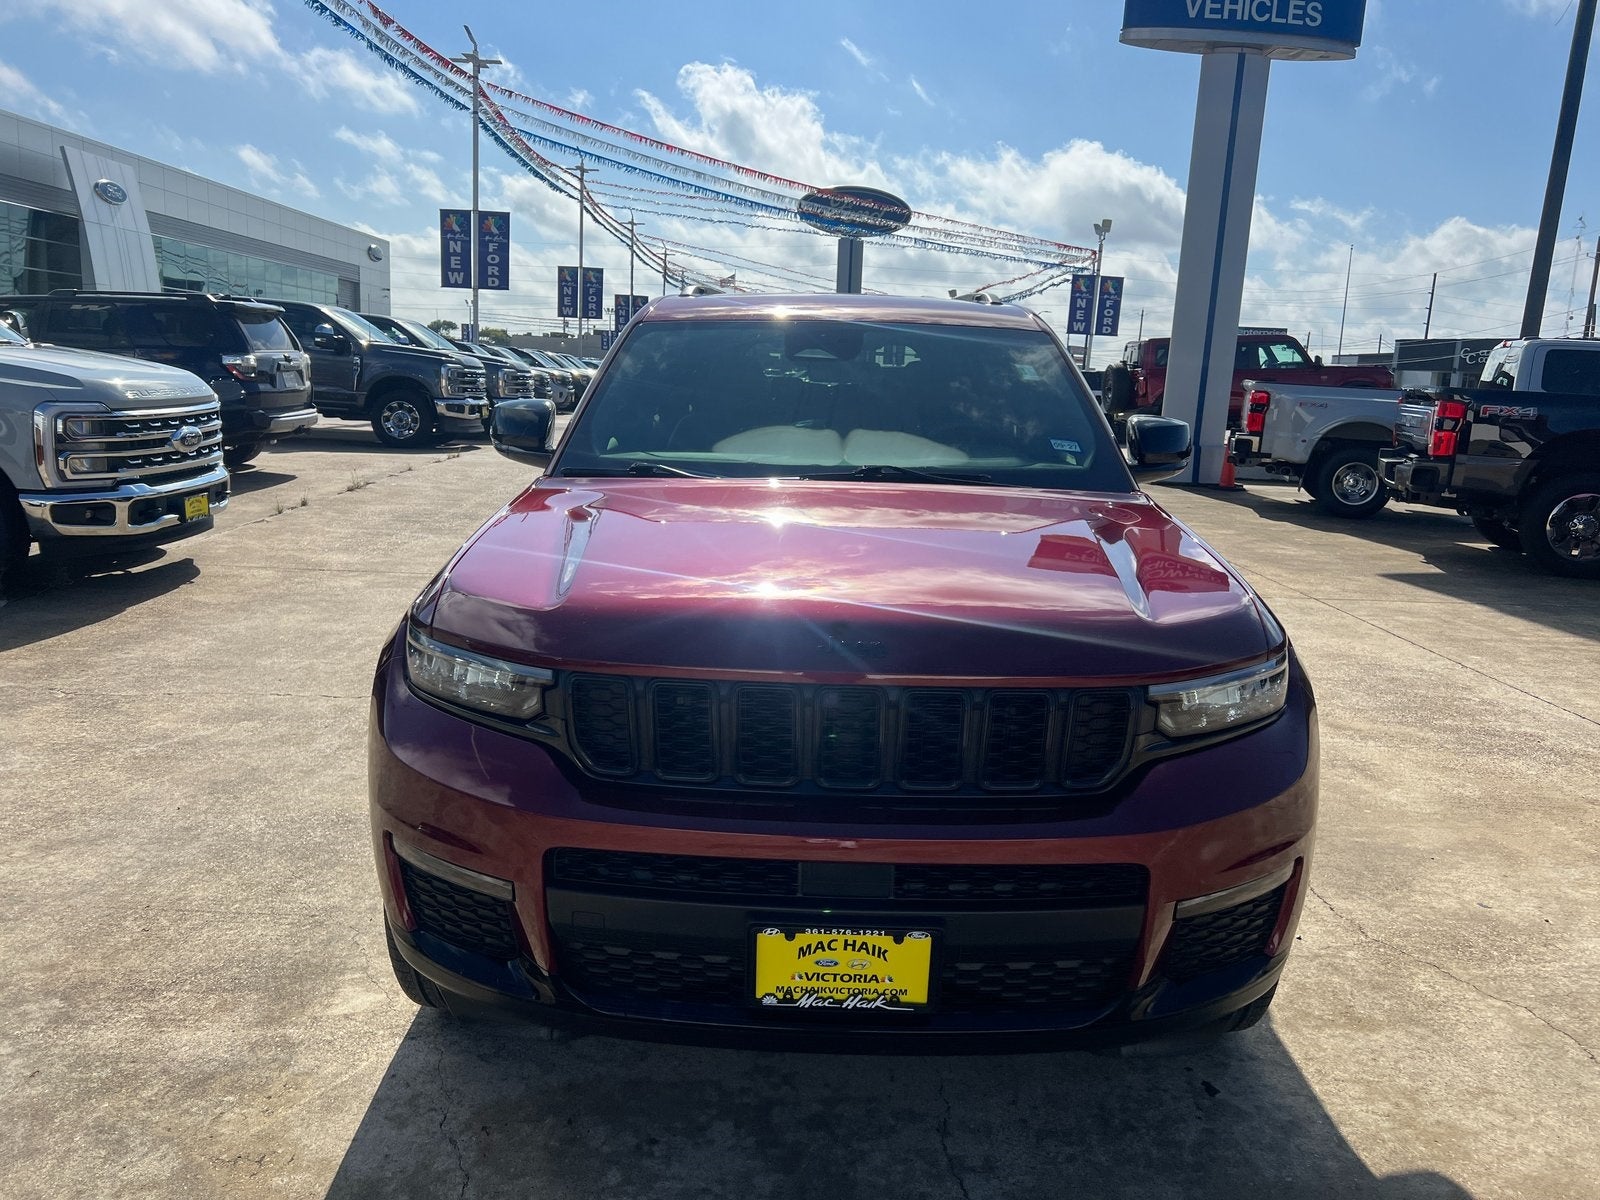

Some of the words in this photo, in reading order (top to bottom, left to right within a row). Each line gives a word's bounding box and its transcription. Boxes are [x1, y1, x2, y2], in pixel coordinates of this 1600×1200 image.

[1186, 0, 1323, 27] VEHICLES
[448, 241, 464, 285] NEW
[487, 243, 500, 287] FORD
[562, 287, 573, 316] NEW
[588, 288, 597, 317] FORD
[1073, 298, 1086, 332] NEW
[1102, 300, 1115, 334] FORD
[1480, 404, 1538, 418] FX4
[797, 938, 838, 960] MAC
[842, 938, 889, 962] HAIK
[803, 972, 880, 984] VICTORIA
[796, 992, 836, 1008] Mac
[842, 994, 890, 1010] Haik
